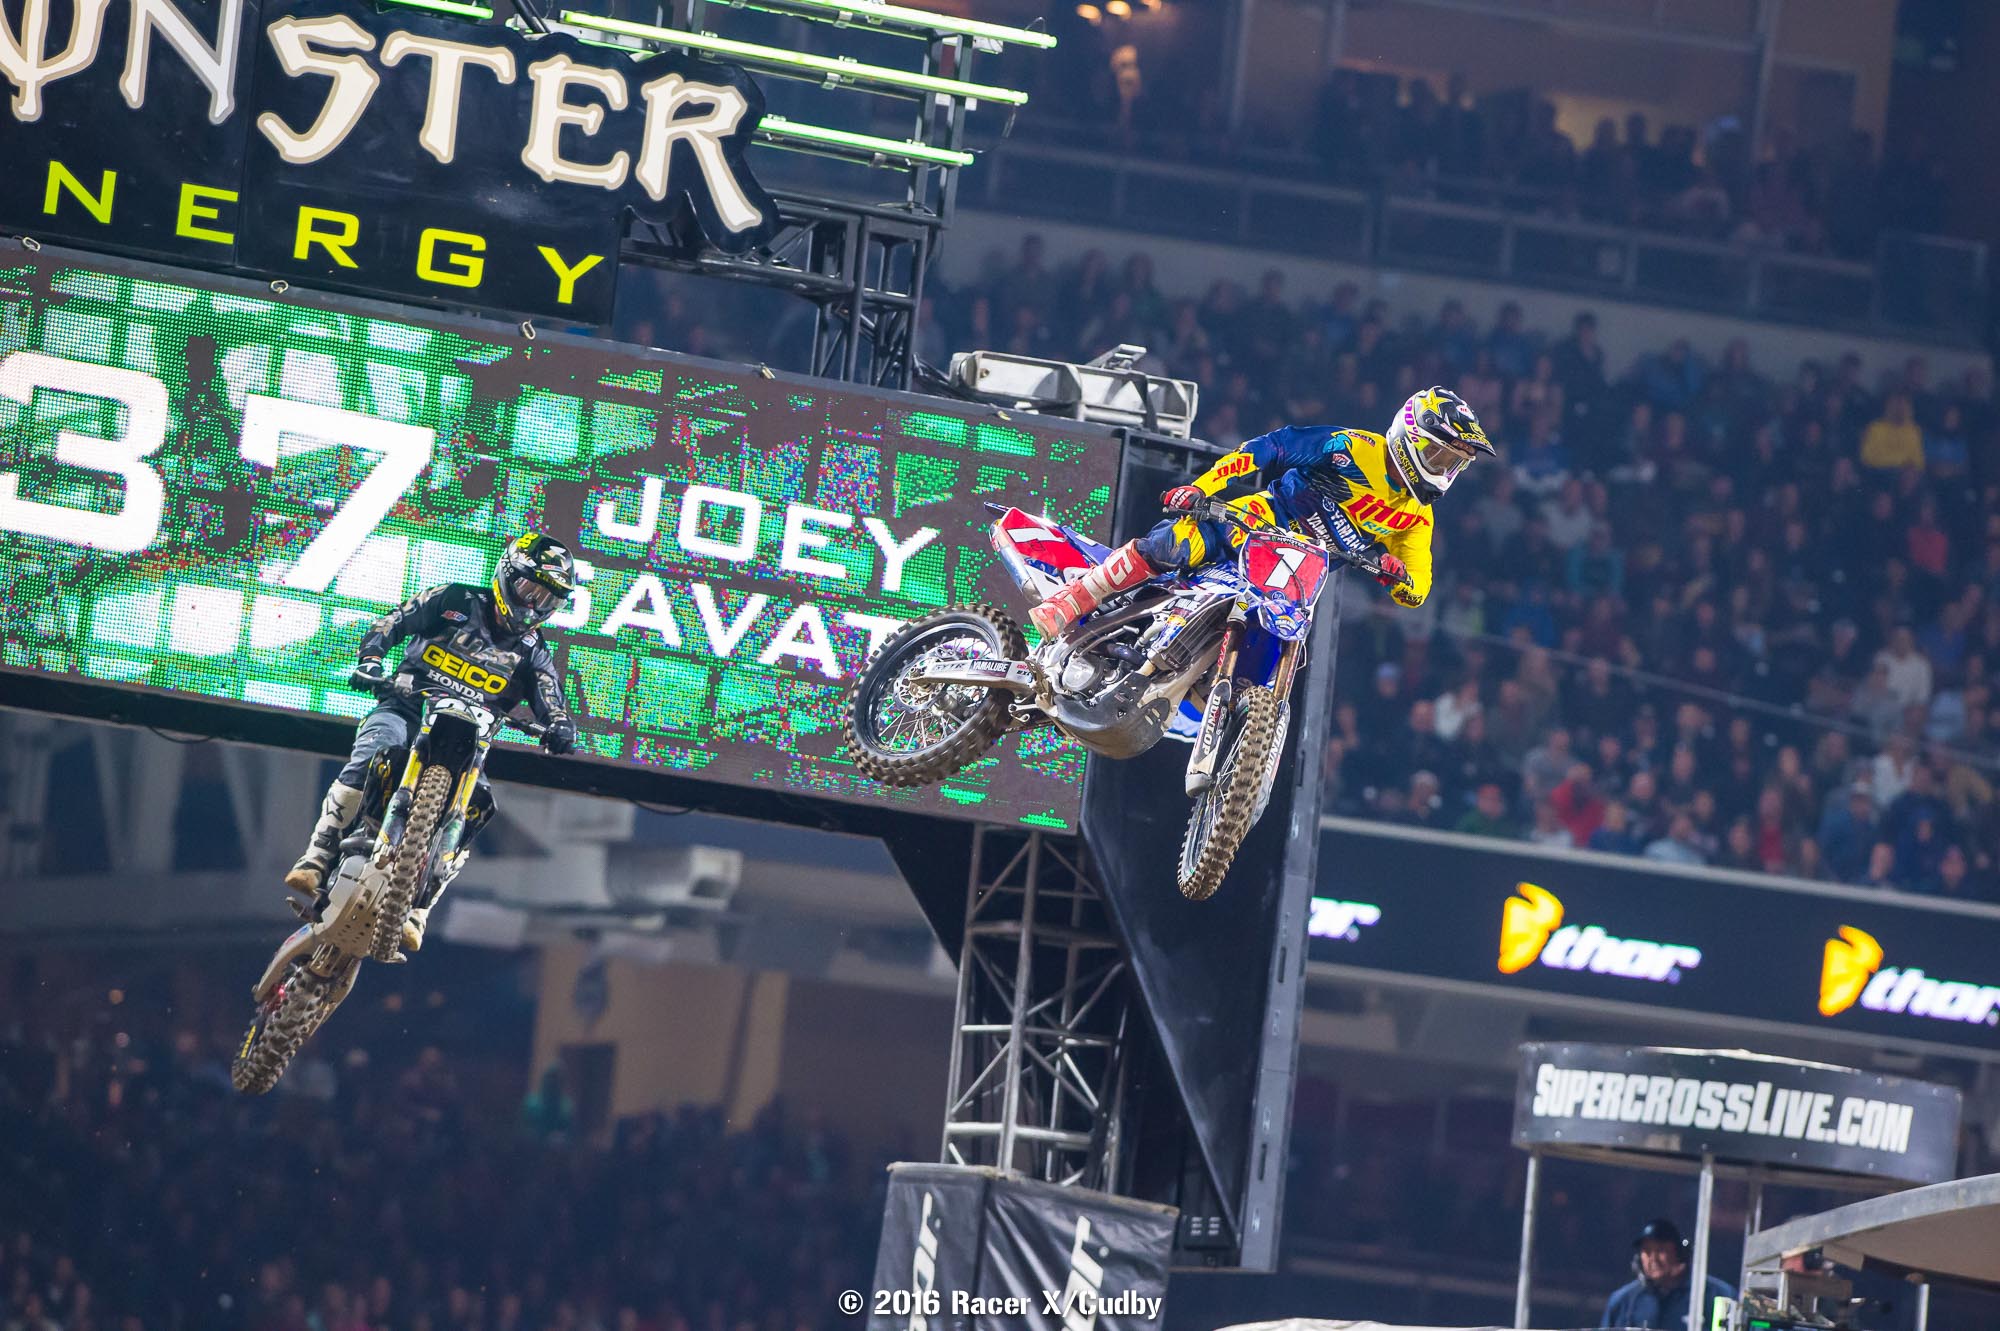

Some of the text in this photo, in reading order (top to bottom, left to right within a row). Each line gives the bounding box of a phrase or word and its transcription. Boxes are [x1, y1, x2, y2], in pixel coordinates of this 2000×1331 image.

[596, 477, 941, 592] JOEY
[1264, 547, 1307, 589] 1
[422, 644, 509, 694] GEICO
[426, 668, 486, 703] HONDA
[973, 660, 1009, 673] YAMALUBE
[1203, 694, 1222, 755] DUNLOP
[1267, 709, 1291, 775] DUNLOP
